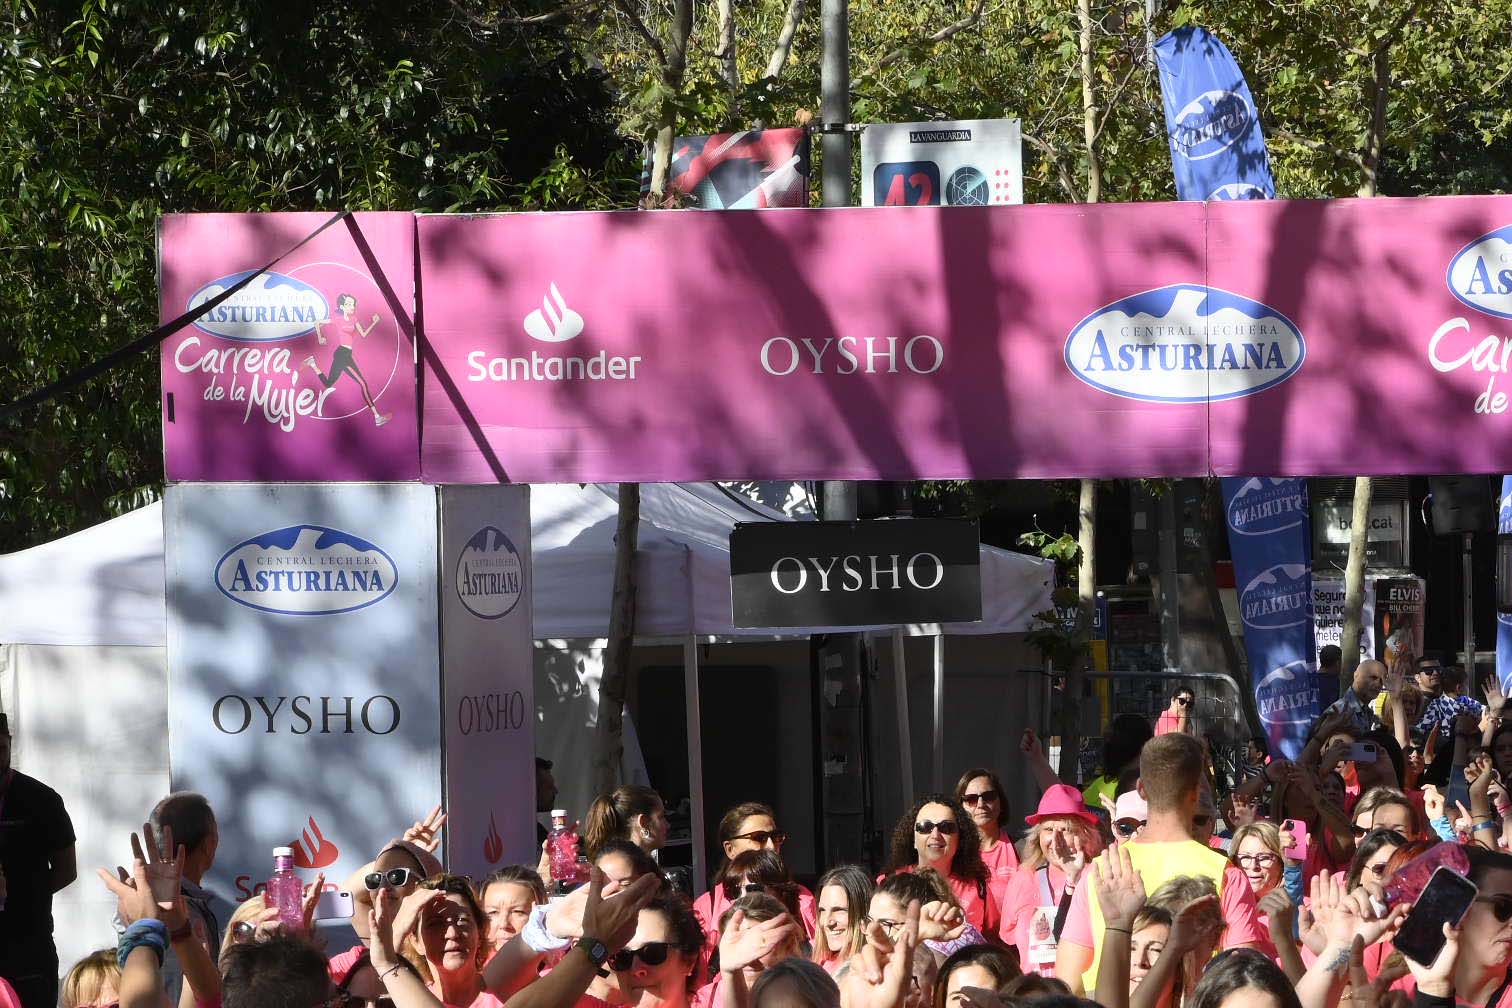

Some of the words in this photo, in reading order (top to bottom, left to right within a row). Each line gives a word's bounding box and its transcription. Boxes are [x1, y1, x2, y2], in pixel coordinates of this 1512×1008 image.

[922, 131, 970, 142] VANGUARDIA
[1087, 328, 1287, 372] ASTURIANA
[1121, 325, 1196, 337] CENTRAL
[1204, 324, 1279, 336] LECHERA
[174, 336, 292, 375] Carrera
[467, 350, 641, 382] Santander
[760, 335, 944, 376] OYSHO
[203, 376, 225, 401] de
[230, 375, 246, 401] la
[243, 371, 337, 433] Mujer
[1474, 375, 1509, 416] de
[228, 558, 385, 593] ASTURIANA
[257, 556, 313, 566] CENTRAL
[320, 555, 379, 566] LECHERA
[461, 561, 519, 596] ASTURIANA
[770, 552, 944, 594] OYSHO
[1389, 588, 1419, 601] ELVIS
[211, 694, 401, 736] OYSHO
[458, 690, 525, 736] OYSHO
